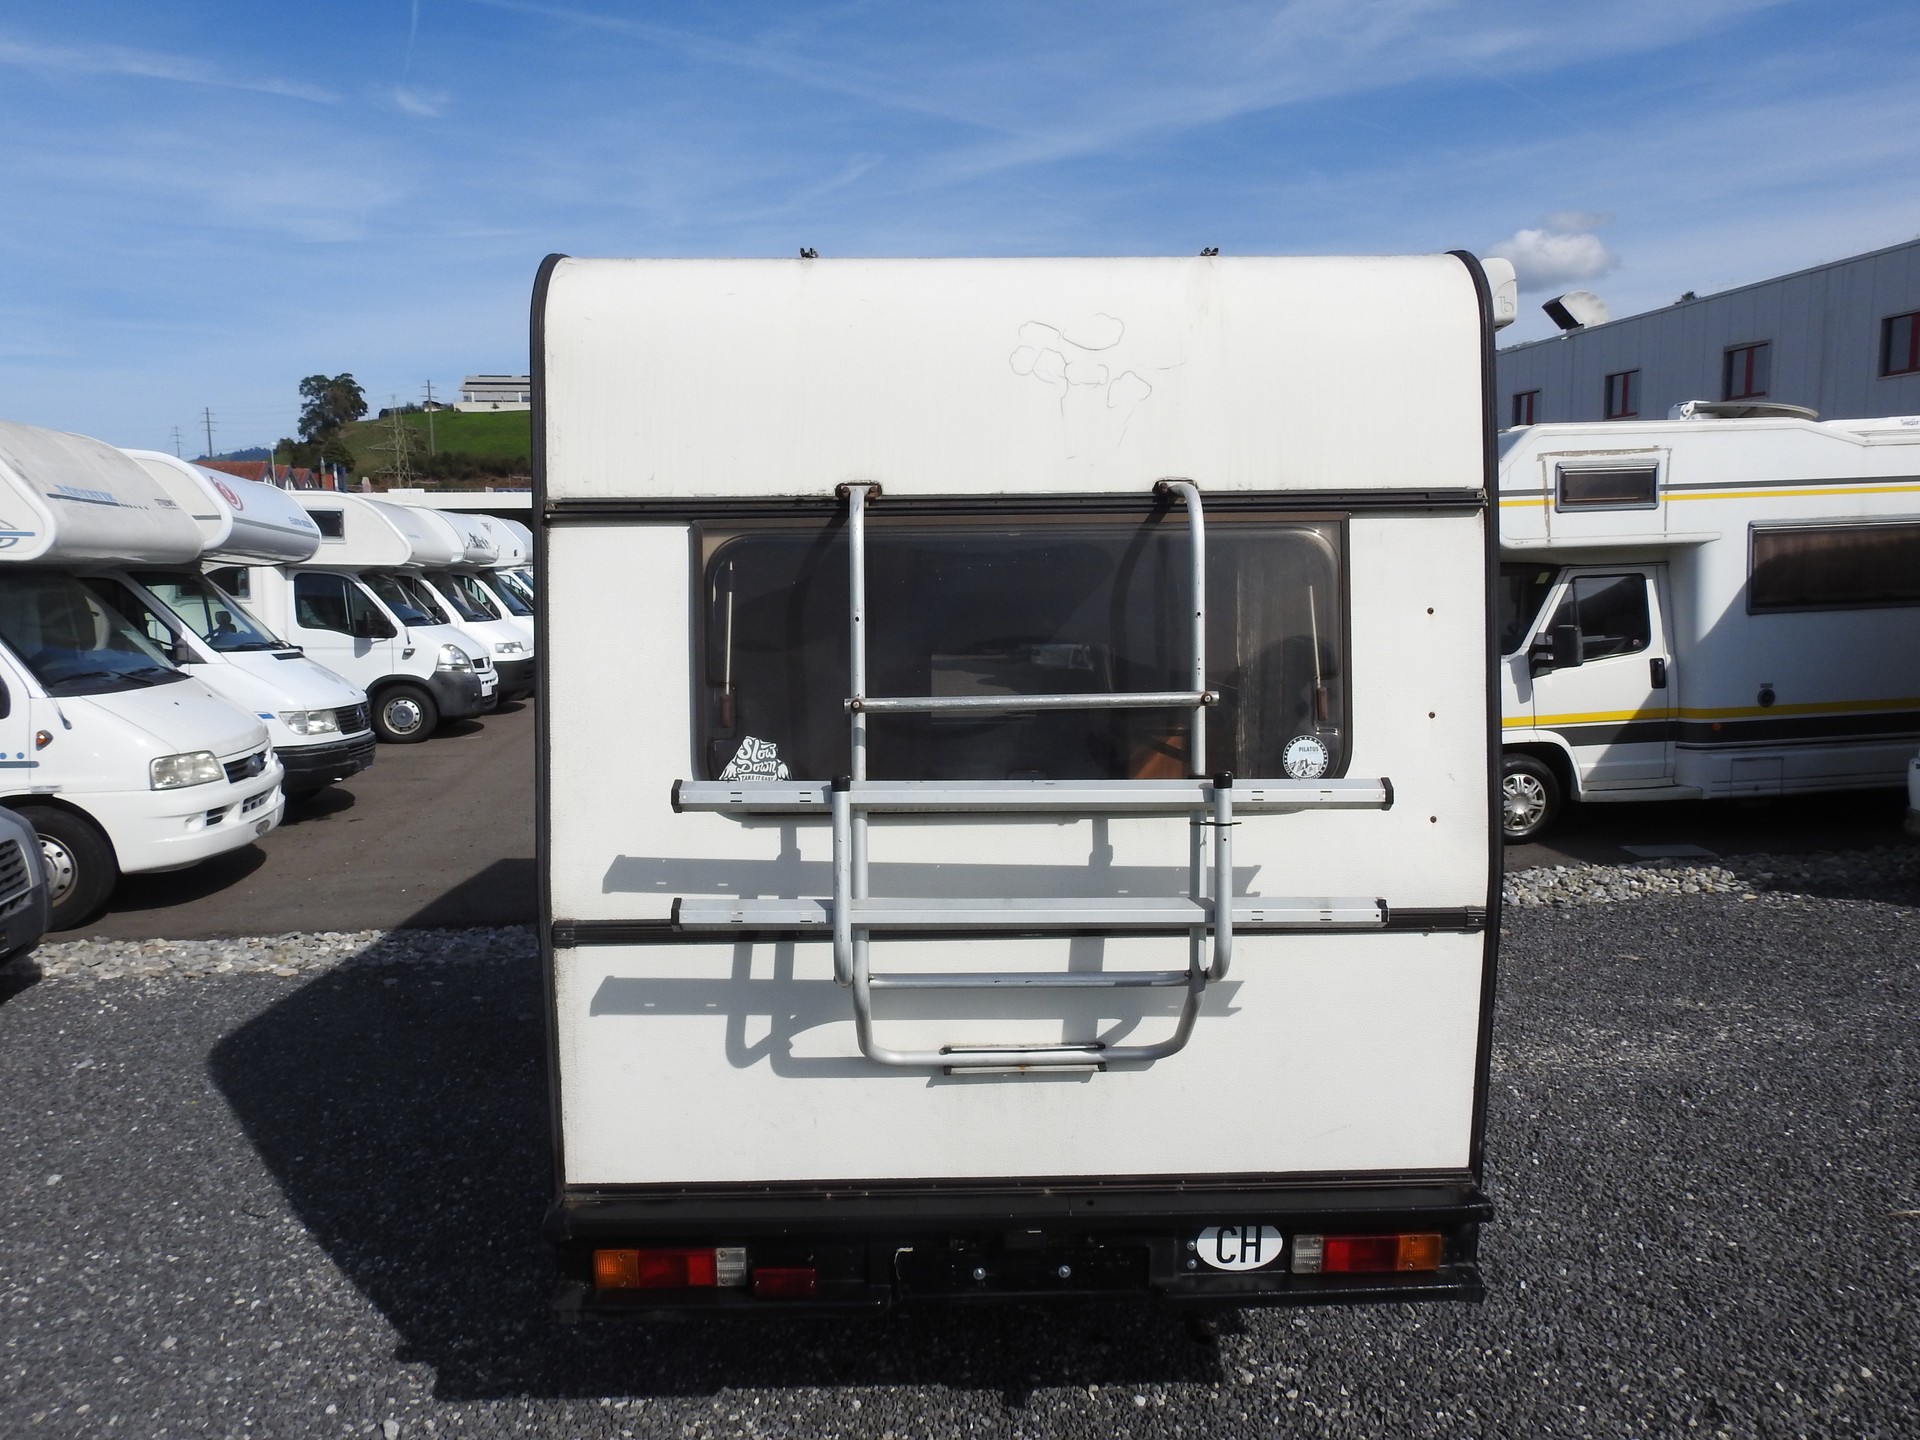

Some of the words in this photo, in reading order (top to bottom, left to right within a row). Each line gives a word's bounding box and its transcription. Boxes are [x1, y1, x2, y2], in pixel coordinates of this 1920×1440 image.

[737, 738, 777, 763] Slow
[736, 758, 777, 774] Down
[1216, 1226, 1262, 1264] CH
